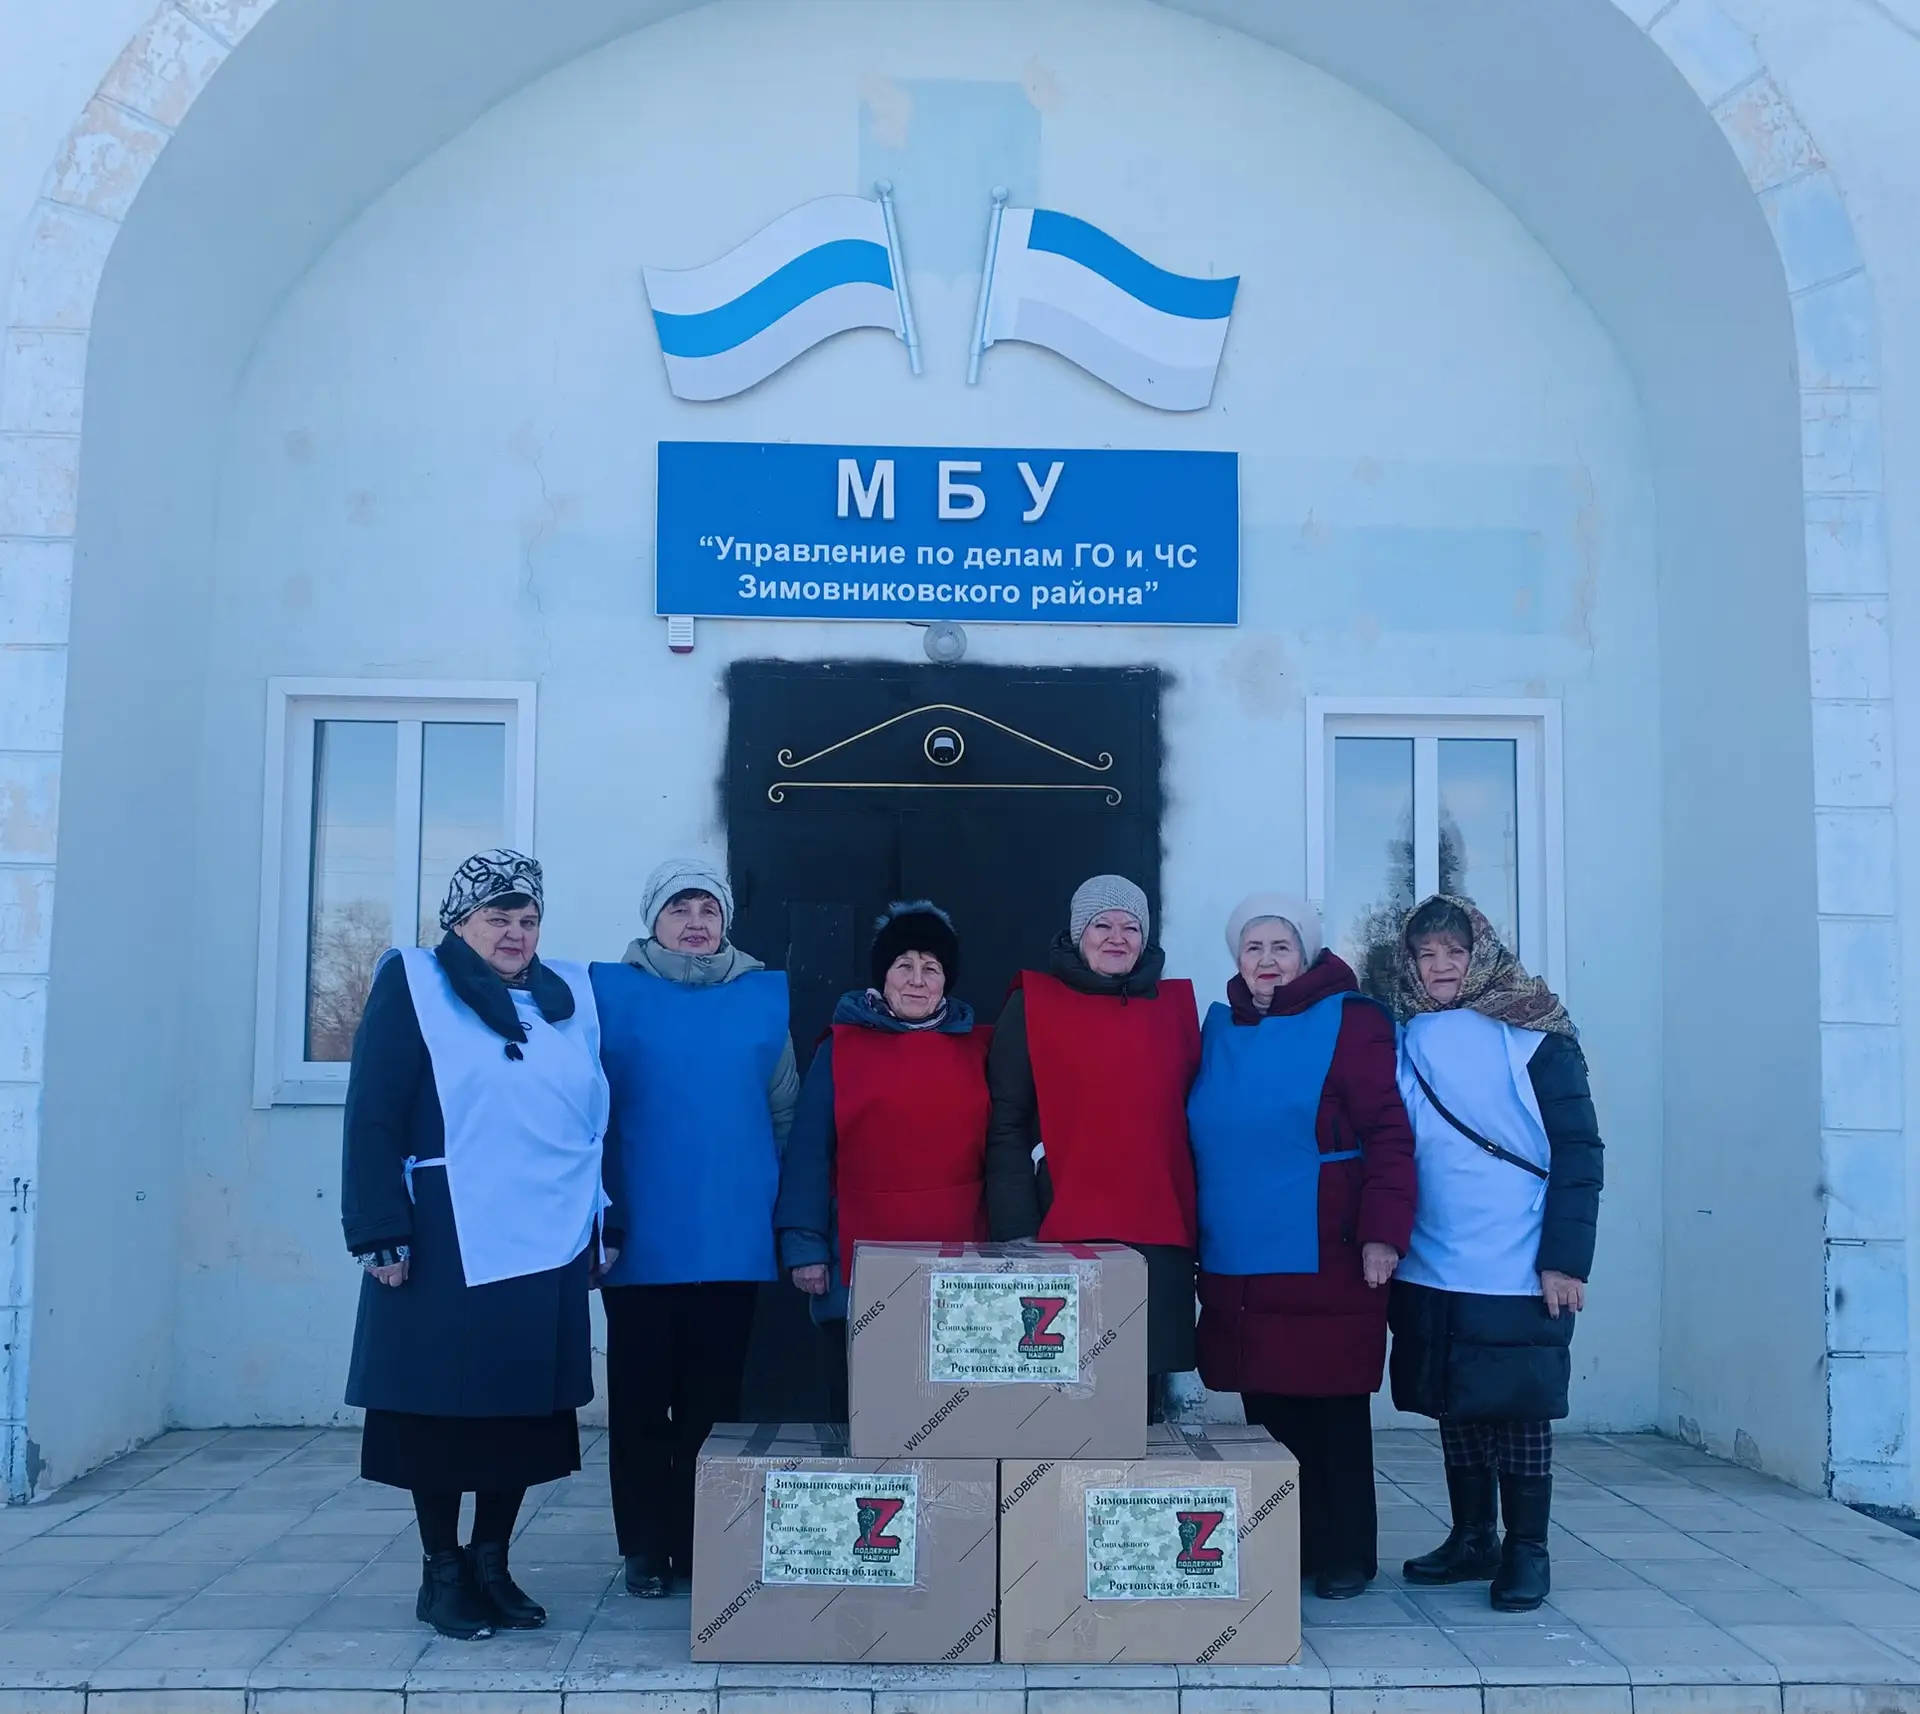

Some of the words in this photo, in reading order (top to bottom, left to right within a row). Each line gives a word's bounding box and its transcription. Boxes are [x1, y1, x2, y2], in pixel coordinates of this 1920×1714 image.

[916, 546, 955, 566] по
[964, 547, 1063, 570] делам
[1073, 544, 1116, 568] ГО
[1125, 549, 1144, 568] и
[1153, 544, 1198, 569] ЧС
[737, 575, 1021, 604] Зимовниковского
[939, 1279, 1034, 1291] Зимовниковский
[1037, 1281, 1070, 1292] район
[951, 1363, 1014, 1373] Ростовская
[1017, 1363, 1061, 1373] область
[903, 1387, 970, 1453] WILDBERRIES
[774, 1478, 872, 1491] Зимовниковский
[875, 1481, 909, 1494] район
[1093, 1495, 1191, 1506] Зимовниковский
[1194, 1495, 1228, 1508] район
[784, 1564, 849, 1576] Ростовская
[851, 1566, 896, 1577] область
[1109, 1580, 1173, 1591] Ростовская
[1176, 1579, 1221, 1590] область
